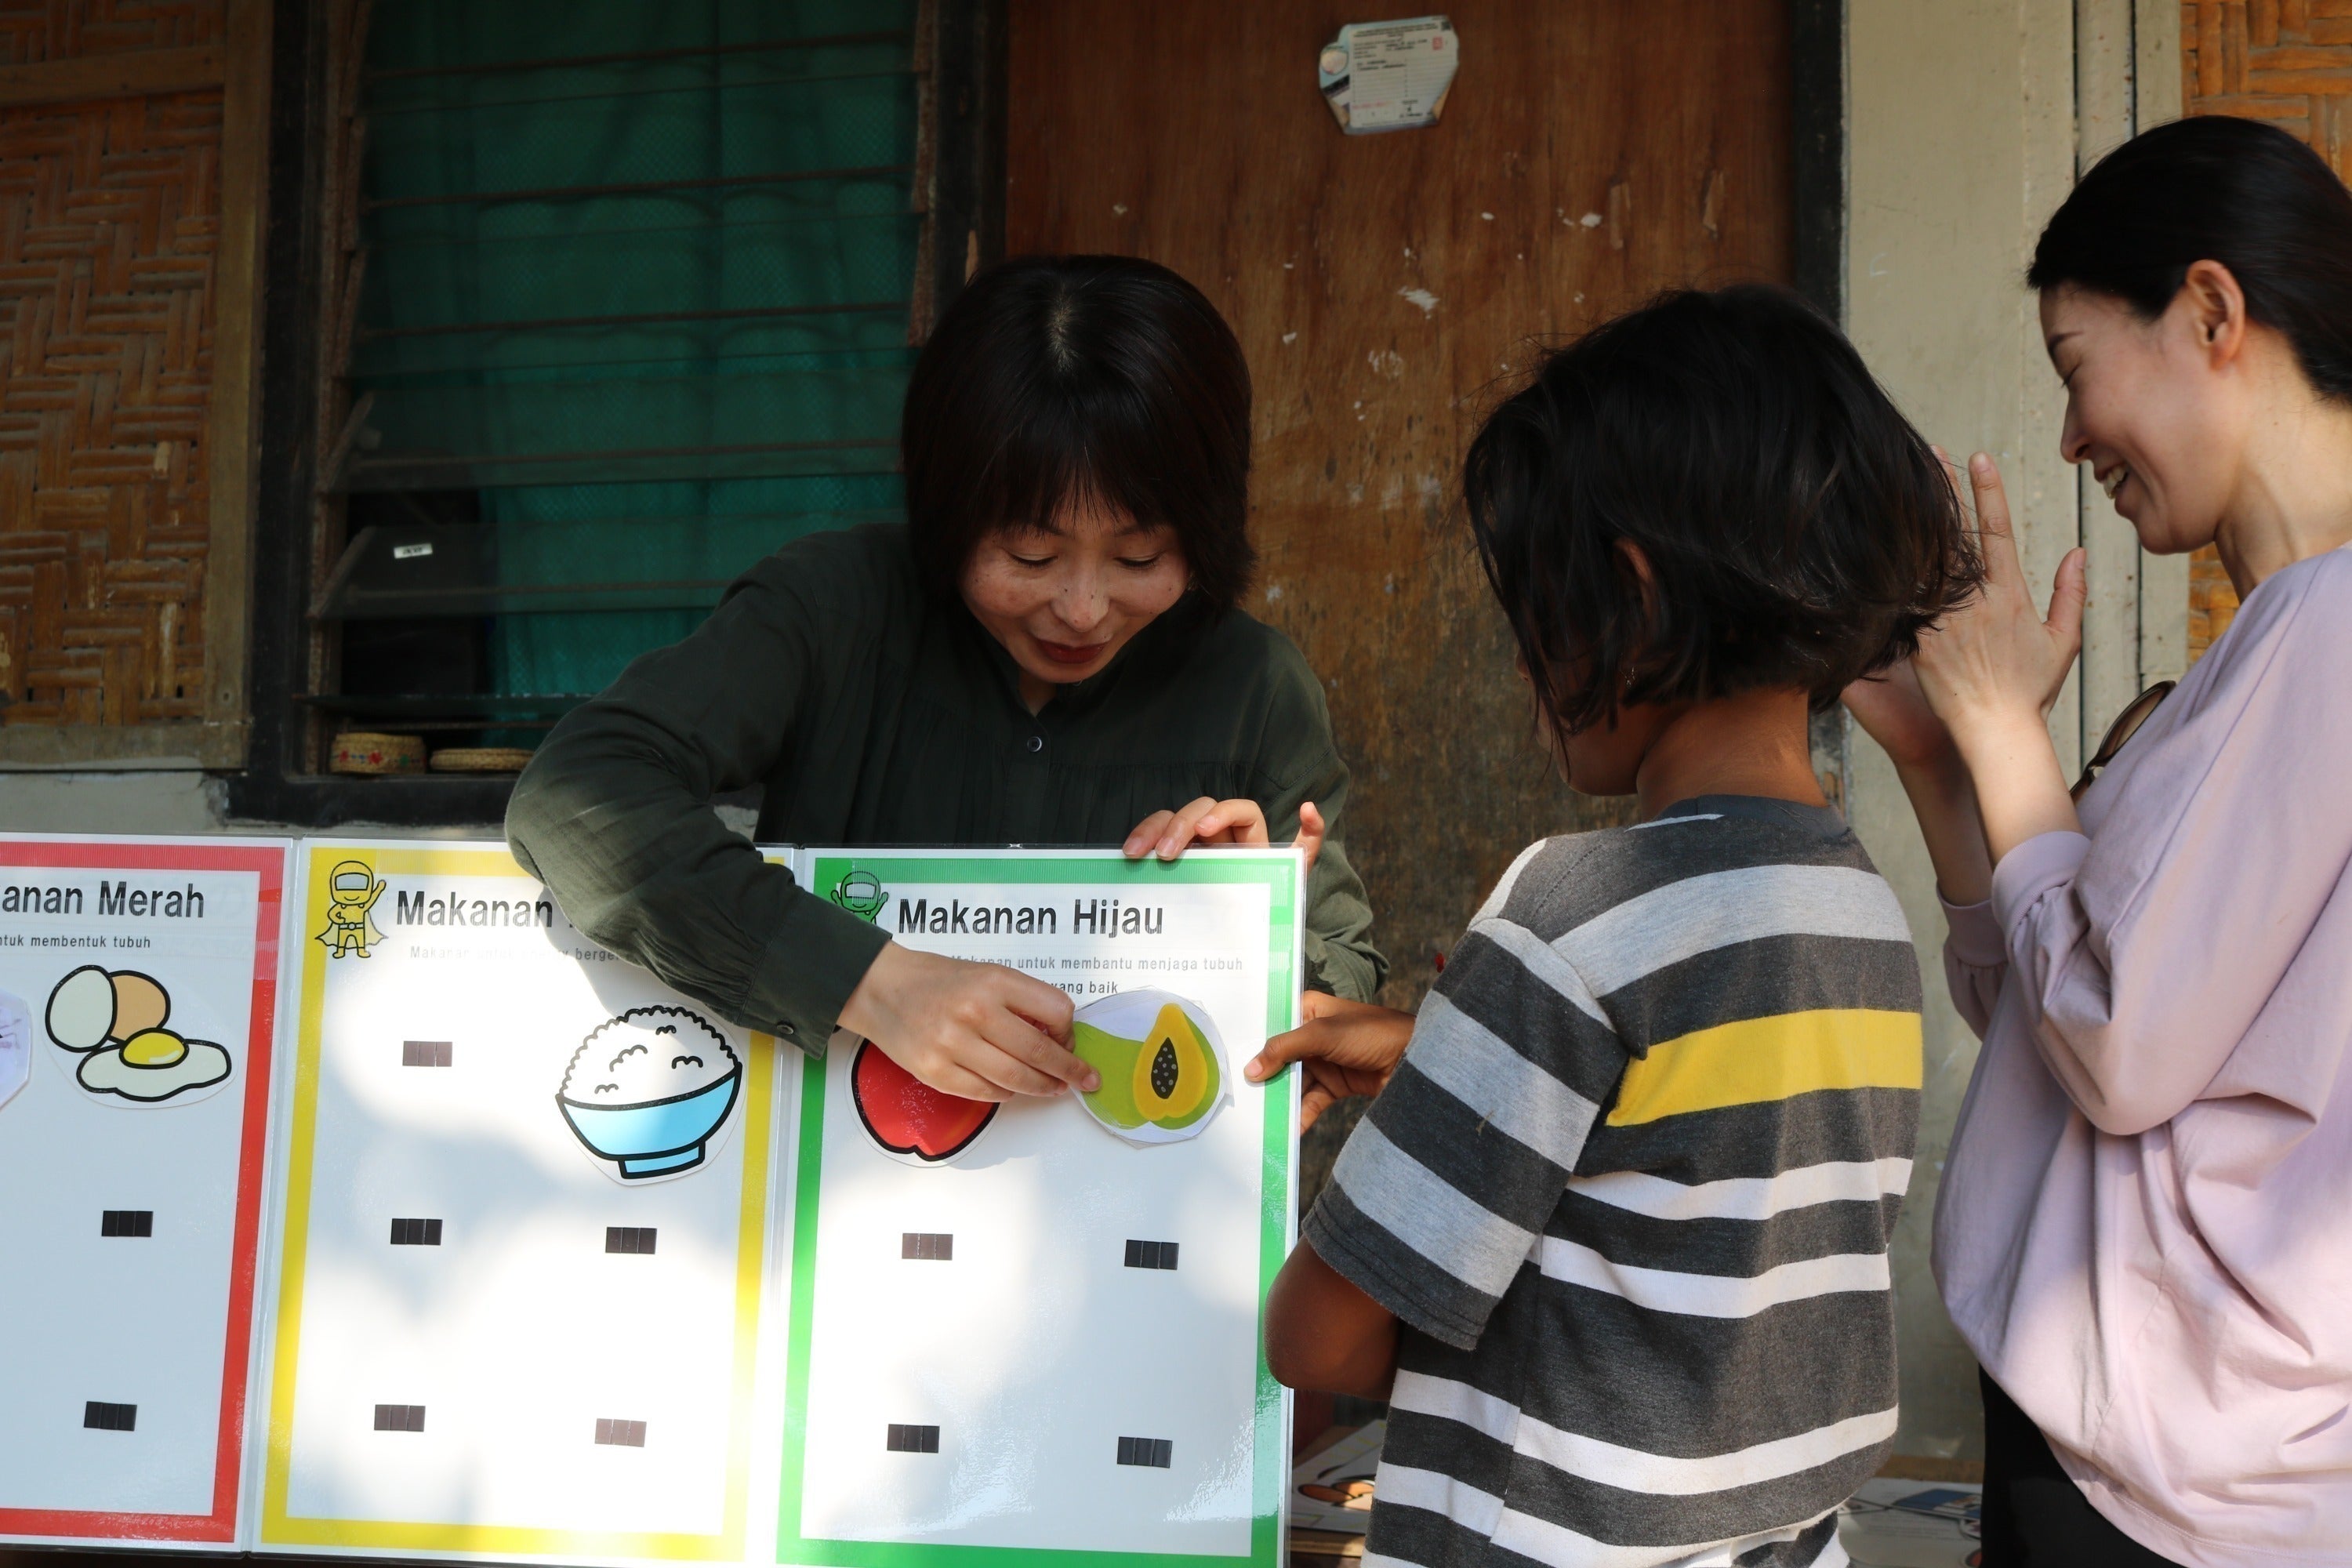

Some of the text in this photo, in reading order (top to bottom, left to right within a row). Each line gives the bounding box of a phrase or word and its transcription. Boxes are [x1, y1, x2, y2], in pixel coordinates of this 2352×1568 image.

[0, 880, 205, 918] anan Merah
[397, 890, 554, 928] Makanan
[898, 898, 1163, 938] Makanan Hijau
[31, 935, 107, 948] membentuk
[113, 936, 151, 949] tubuh
[575, 946, 619, 962] berge
[1017, 956, 1056, 969] untuk
[1061, 956, 1133, 970] membantu
[1138, 957, 1199, 972] menjaga
[1203, 957, 1243, 971] tubuh
[1089, 981, 1118, 994] baik
